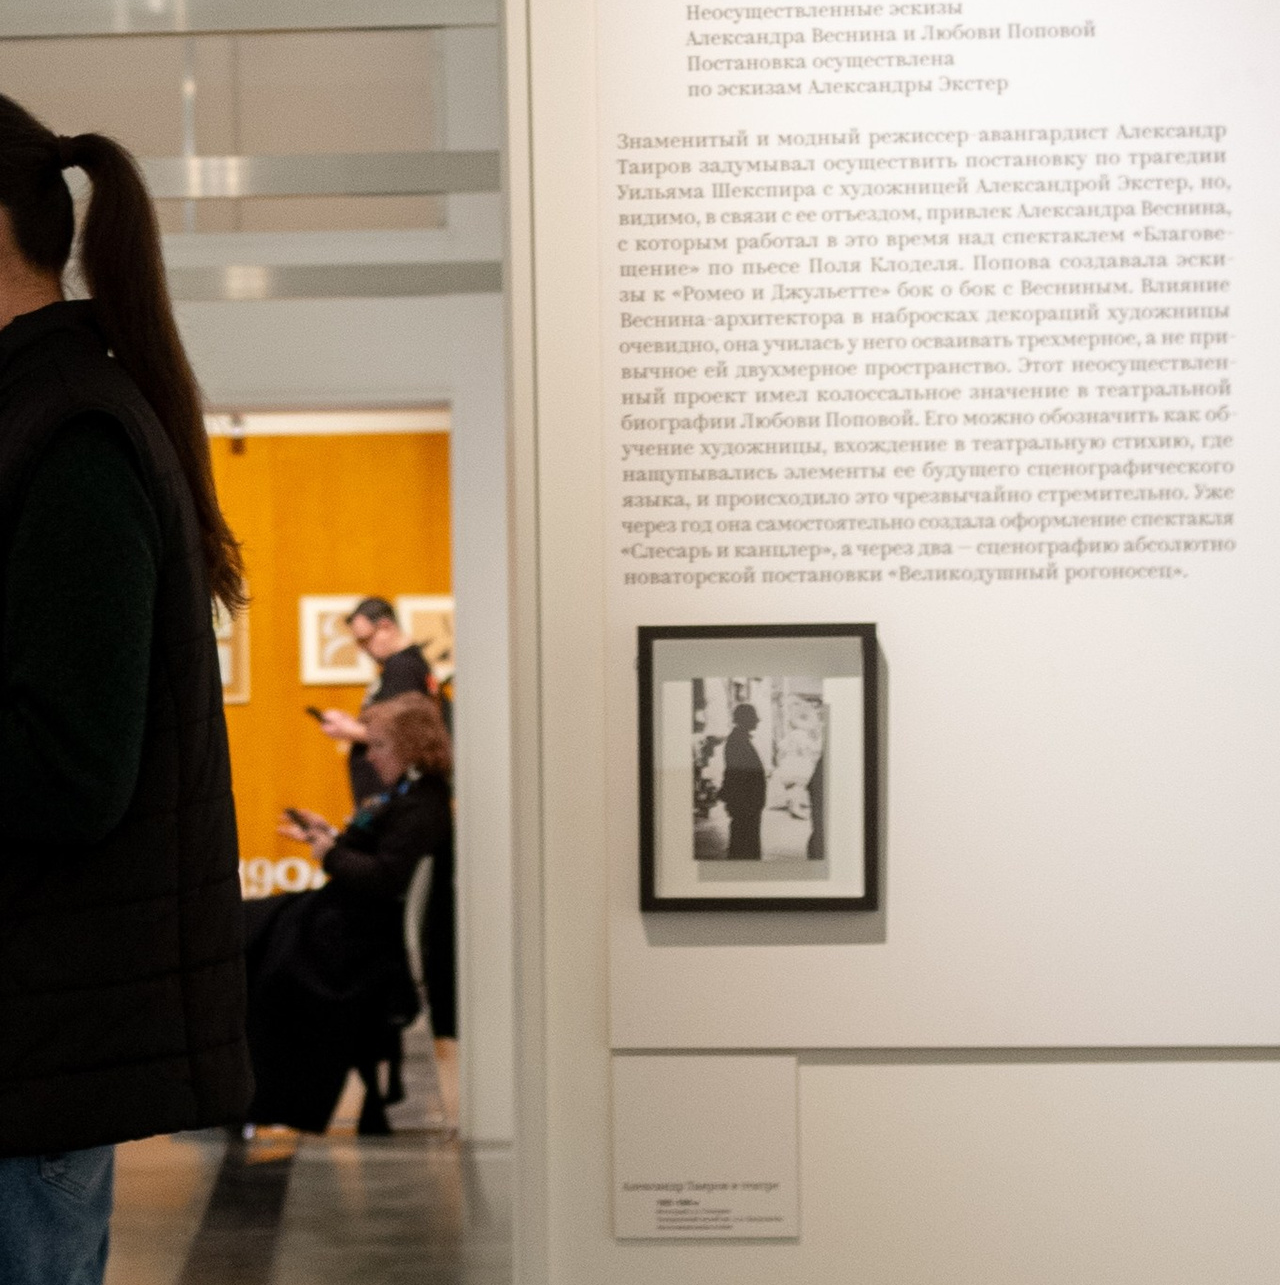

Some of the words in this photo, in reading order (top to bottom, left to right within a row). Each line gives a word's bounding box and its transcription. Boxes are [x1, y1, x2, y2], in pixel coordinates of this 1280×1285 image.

[686, 0, 883, 24] Неосуществленные
[889, 3, 962, 16] эскизы
[686, 27, 805, 50] Александра
[812, 24, 897, 43] Веснина
[903, 28, 916, 41] и
[921, 22, 1001, 40] Любови
[1008, 20, 1095, 38] Поповой
[687, 52, 807, 71] Постановка
[812, 54, 955, 73] осуществлена
[687, 84, 713, 97] по
[718, 83, 802, 96] эскизам
[809, 75, 932, 99] Александры
[940, 74, 1009, 96] Экстер
[617, 130, 749, 149] Знаменитый
[756, 133, 771, 146] и
[778, 128, 861, 149] модный
[1116, 121, 1227, 143] Александр
[617, 157, 692, 179] Таиров
[699, 159, 815, 177] задумывал
[823, 157, 957, 175] осуществить
[966, 154, 1086, 172] постановку
[1095, 152, 1122, 165] по
[1128, 151, 1226, 169] трагедии
[617, 182, 705, 200] Уильяма
[712, 180, 816, 203] Шекспира
[822, 183, 834, 196] с
[840, 177, 968, 200] художницей
[977, 174, 1110, 198] Александрой
[705, 211, 717, 224] в
[720, 211, 777, 224] связи
[780, 210, 792, 223] с
[795, 209, 818, 223] ее
[927, 207, 1012, 224] привлек
[1018, 200, 1136, 223] Александра
[616, 238, 629, 251] с
[635, 238, 728, 255] которым
[736, 231, 818, 253] работал
[826, 234, 839, 248] в
[844, 234, 879, 247] это
[886, 234, 949, 251] время
[957, 232, 995, 248] над
[1002, 231, 1124, 244] спектаклем
[620, 264, 699, 280] щение»
[707, 262, 735, 275] по
[742, 262, 800, 275] пьесе
[809, 256, 861, 273] Поля
[974, 253, 1051, 270] Попова
[1059, 256, 1168, 272] создавала
[618, 289, 646, 302] зы
[652, 289, 666, 302] к
[672, 284, 745, 301] «Ромео
[751, 287, 765, 300] и
[771, 281, 890, 304] Джульетте»
[896, 279, 934, 298] бок
[940, 284, 954, 297] о
[958, 278, 996, 297] бок
[1002, 283, 1014, 296] с
[1141, 275, 1230, 293] Влияние
[852, 311, 864, 324] в
[871, 305, 978, 328] набросках
[986, 303, 1099, 326] декораций
[1108, 306, 1230, 324] художницы
[722, 338, 760, 352] она
[763, 338, 844, 355] училась
[846, 337, 859, 354] у
[863, 337, 907, 350] него
[911, 335, 1013, 349] осваивать
[1144, 332, 1158, 345] а
[1160, 331, 1186, 345] не
[621, 366, 697, 379] вычное
[703, 360, 729, 378] ей
[735, 364, 857, 381] двухмерное
[1019, 355, 1064, 373] Этот
[621, 386, 666, 405] ный
[674, 391, 747, 408] проект
[755, 390, 808, 402] имел
[817, 388, 961, 401] колоссальное
[970, 386, 1069, 399] значение
[1076, 384, 1090, 398] в
[1096, 379, 1231, 401] театральной
[621, 412, 736, 434] биографии
[740, 410, 820, 428] Любови
[924, 407, 959, 426] Его
[963, 412, 1035, 425] можно
[1039, 405, 1159, 424] обозначить
[1163, 408, 1201, 422] как
[621, 443, 694, 461] учение
[834, 439, 947, 456] вхождение
[954, 438, 966, 452] в
[972, 437, 1106, 456] театральную
[1201, 434, 1234, 451] где
[623, 467, 778, 487] нащупывались
[785, 466, 886, 480] элементы
[892, 464, 916, 478] ее
[922, 458, 1020, 483] будущего
[1027, 456, 1235, 481] сценографического
[696, 494, 710, 507] и
[716, 493, 850, 511] происходило
[855, 491, 890, 505] это
[893, 486, 1032, 508] чрезвычайно
[1193, 481, 1235, 500] Уже
[622, 521, 677, 538] через
[680, 519, 713, 535] год
[715, 519, 753, 532] она
[756, 518, 915, 531] самостоятельно
[918, 517, 996, 532] создала
[1000, 510, 1127, 532] оформление
[1131, 513, 1234, 526] спектакля
